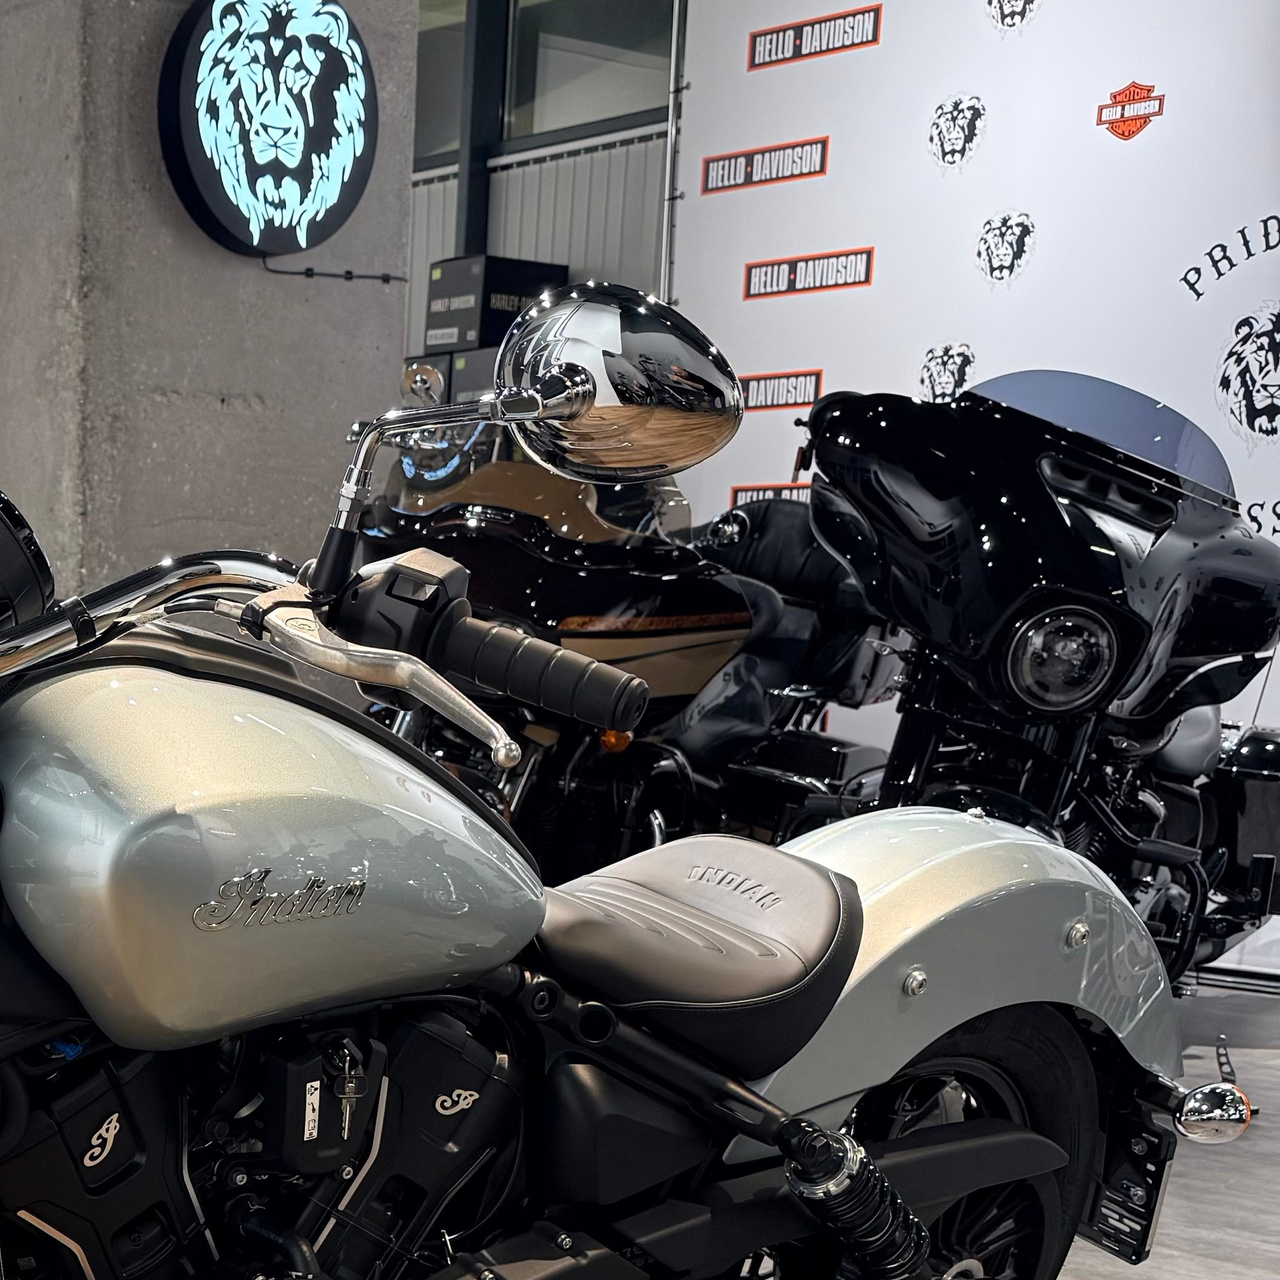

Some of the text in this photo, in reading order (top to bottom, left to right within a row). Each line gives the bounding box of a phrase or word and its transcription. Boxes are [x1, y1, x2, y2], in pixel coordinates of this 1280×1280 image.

[754, 11, 875, 65] HELLO DAVIDSON
[707, 143, 822, 190] HELLO DAVIDSON
[749, 253, 867, 296] HELLO DAVIDSON
[747, 375, 817, 408] DAVIDSON
[192, 867, 367, 932] Indian
[687, 865, 782, 912] INDIAN
